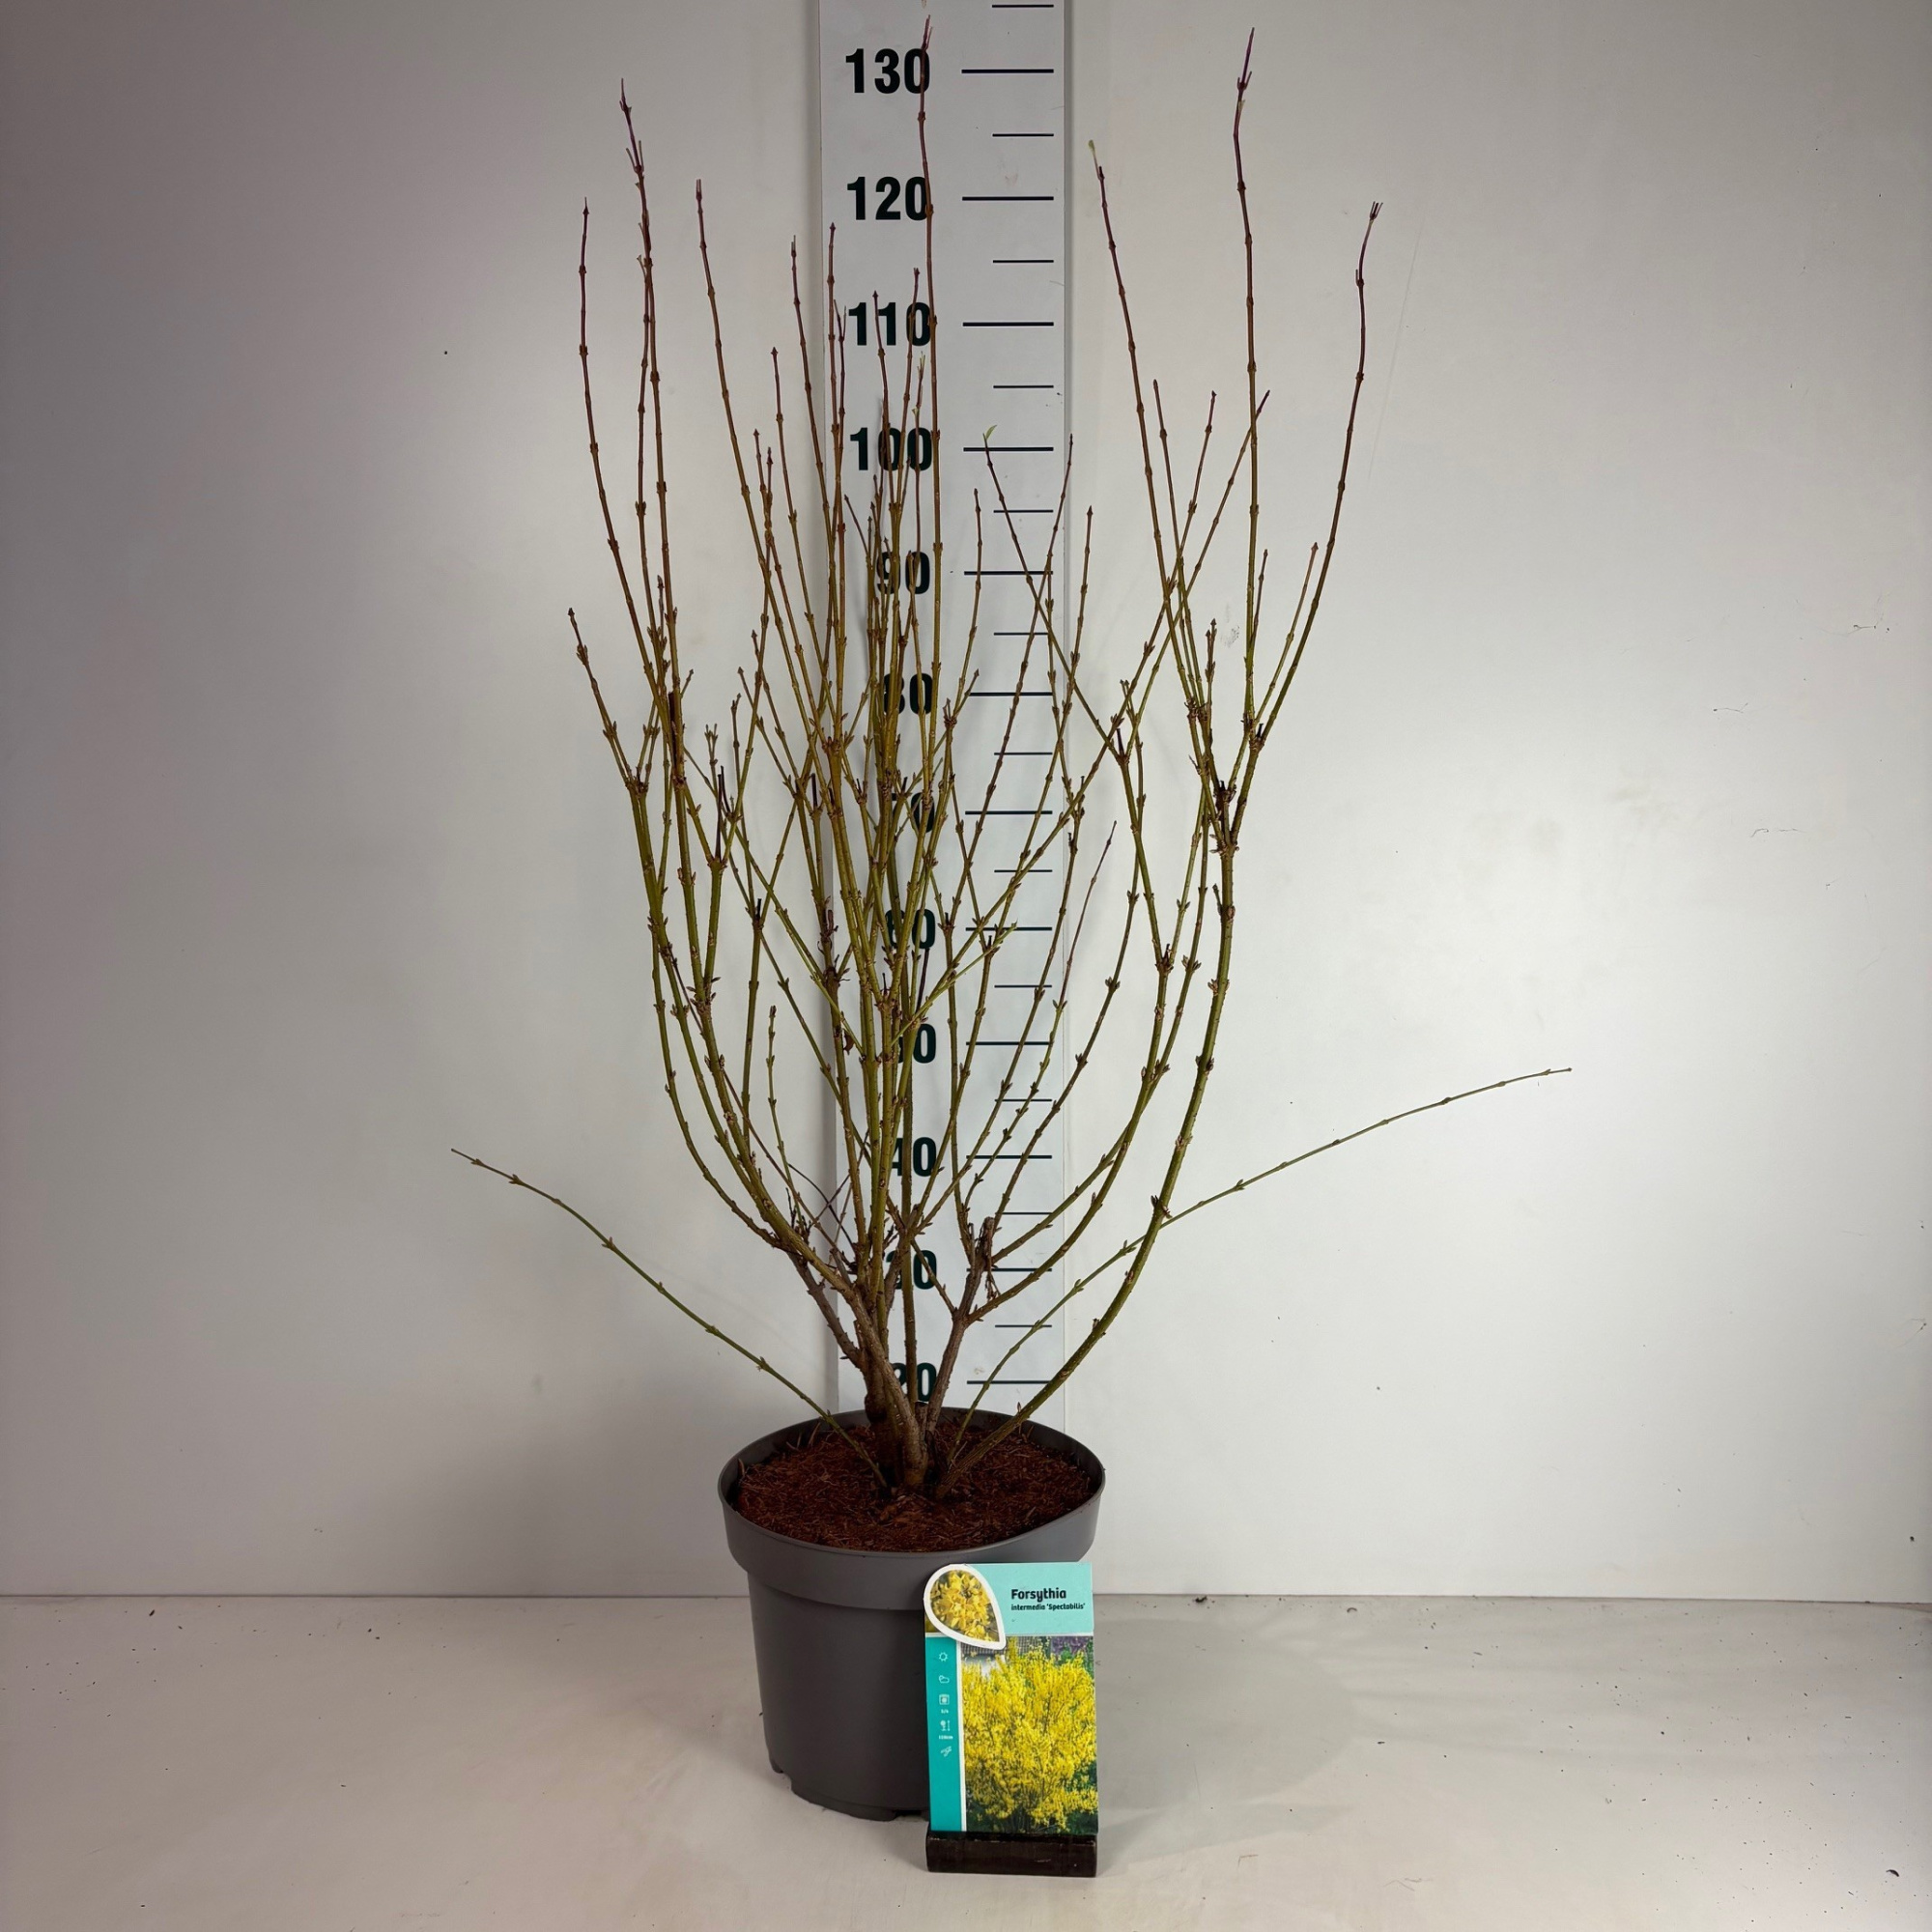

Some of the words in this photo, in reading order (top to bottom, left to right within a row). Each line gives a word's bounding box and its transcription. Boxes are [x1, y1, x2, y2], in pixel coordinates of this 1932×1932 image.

[845, 48, 930, 94] 130
[847, 176, 930, 220] 120
[848, 302, 931, 346] 110
[850, 427, 933, 470] 100
[876, 552, 930, 594] 90
[889, 791, 935, 832] 0
[893, 1024, 936, 1064] 0
[1010, 1587, 1066, 1603] Forsythia
